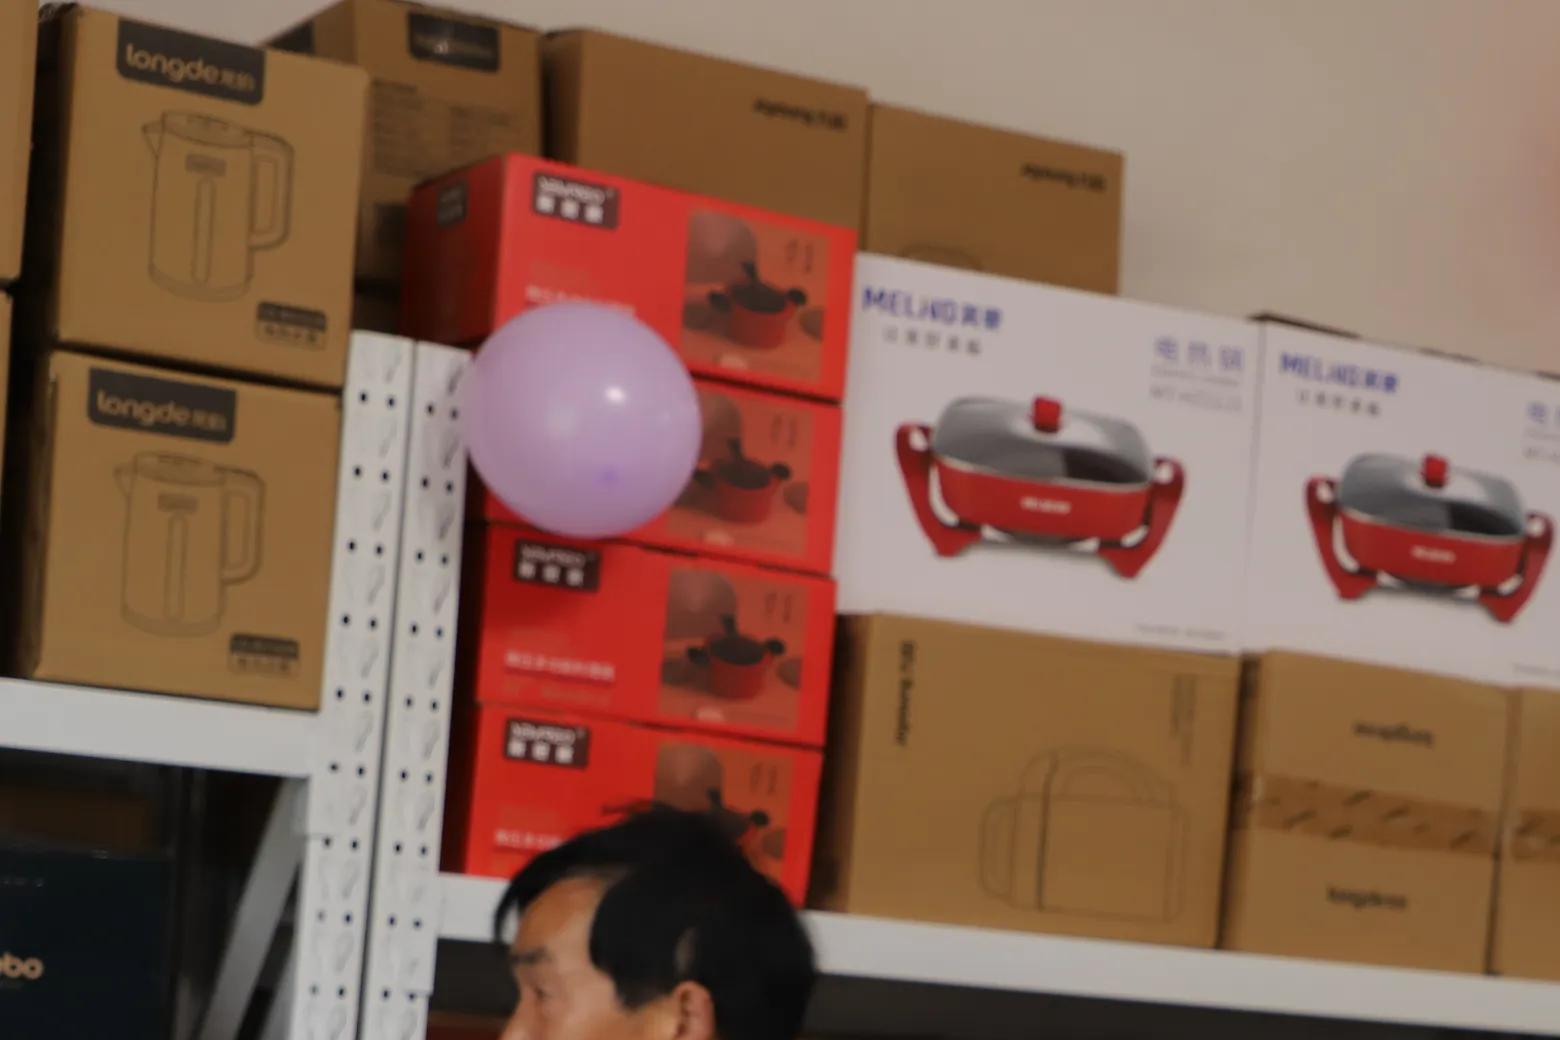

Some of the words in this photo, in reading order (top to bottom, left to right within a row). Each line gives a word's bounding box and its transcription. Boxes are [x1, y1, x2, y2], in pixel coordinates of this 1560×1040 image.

[125, 42, 219, 83] longde
[96, 389, 191, 427] longde
[0, 951, 44, 980] bo
